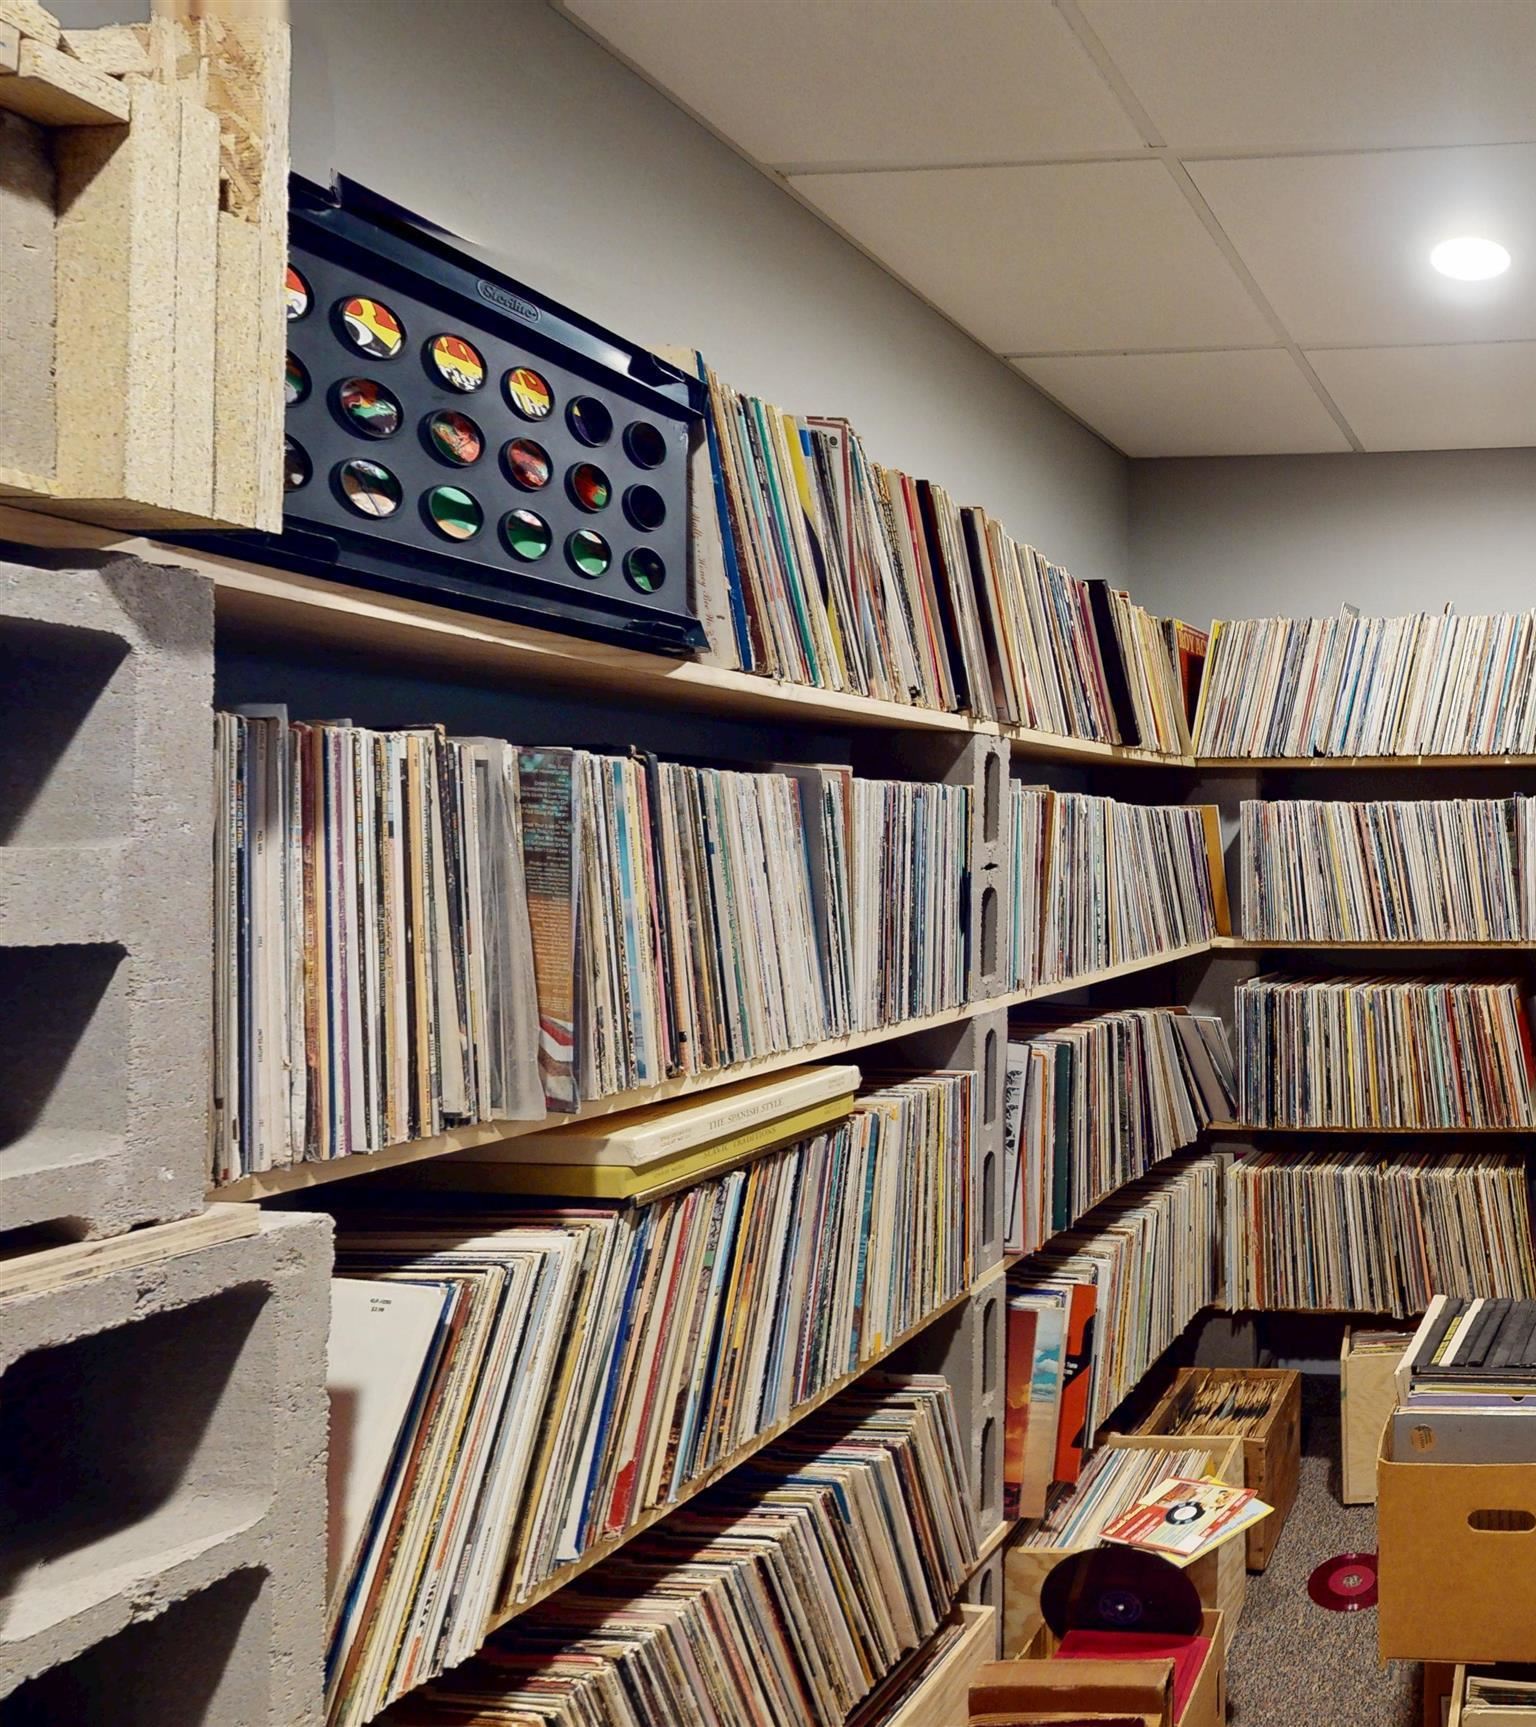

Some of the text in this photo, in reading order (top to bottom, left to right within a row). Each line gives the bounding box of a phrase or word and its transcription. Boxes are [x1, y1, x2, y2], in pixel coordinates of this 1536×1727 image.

[482, 284, 535, 319] Sterilite
[708, 1098, 784, 1130] THE SPANISH STYLE
